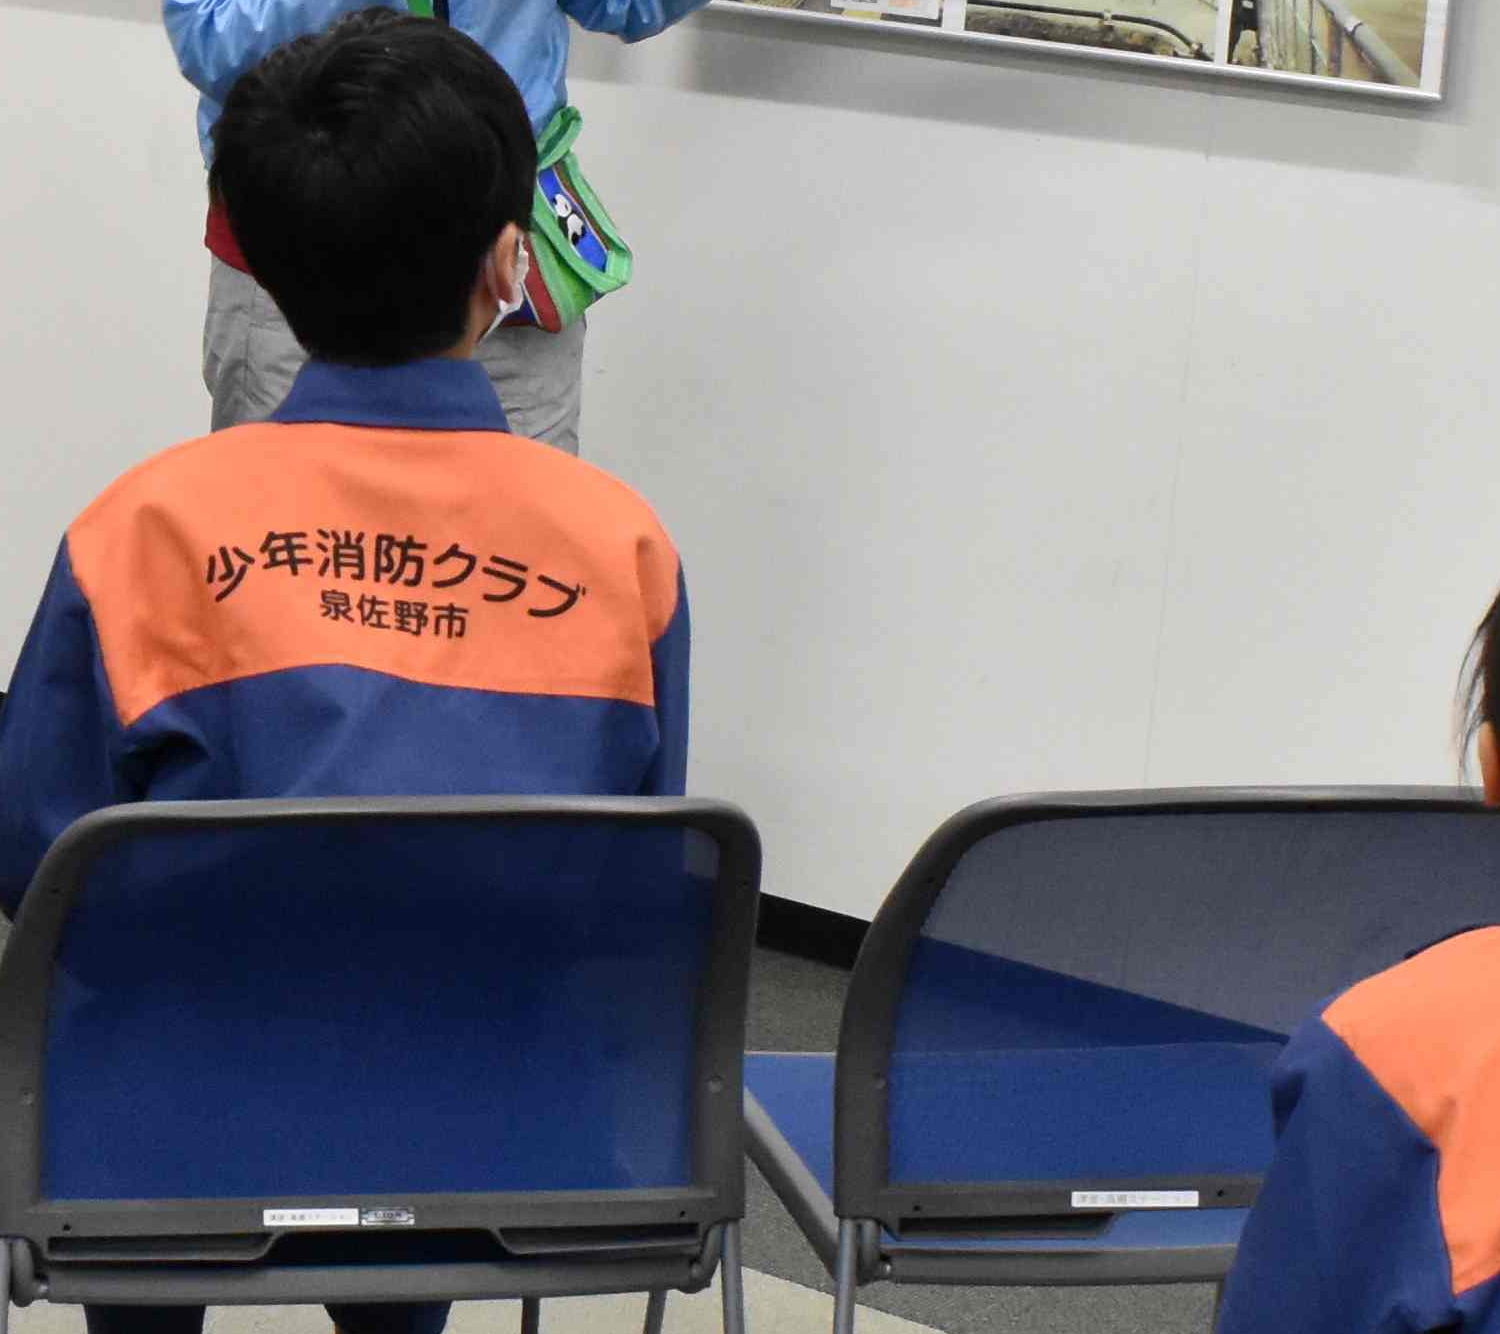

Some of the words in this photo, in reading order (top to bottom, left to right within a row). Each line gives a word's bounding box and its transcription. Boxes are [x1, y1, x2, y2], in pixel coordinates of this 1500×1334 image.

[206, 529, 587, 619] 少年消防クラブ
[319, 588, 470, 639] 泉佐野市
